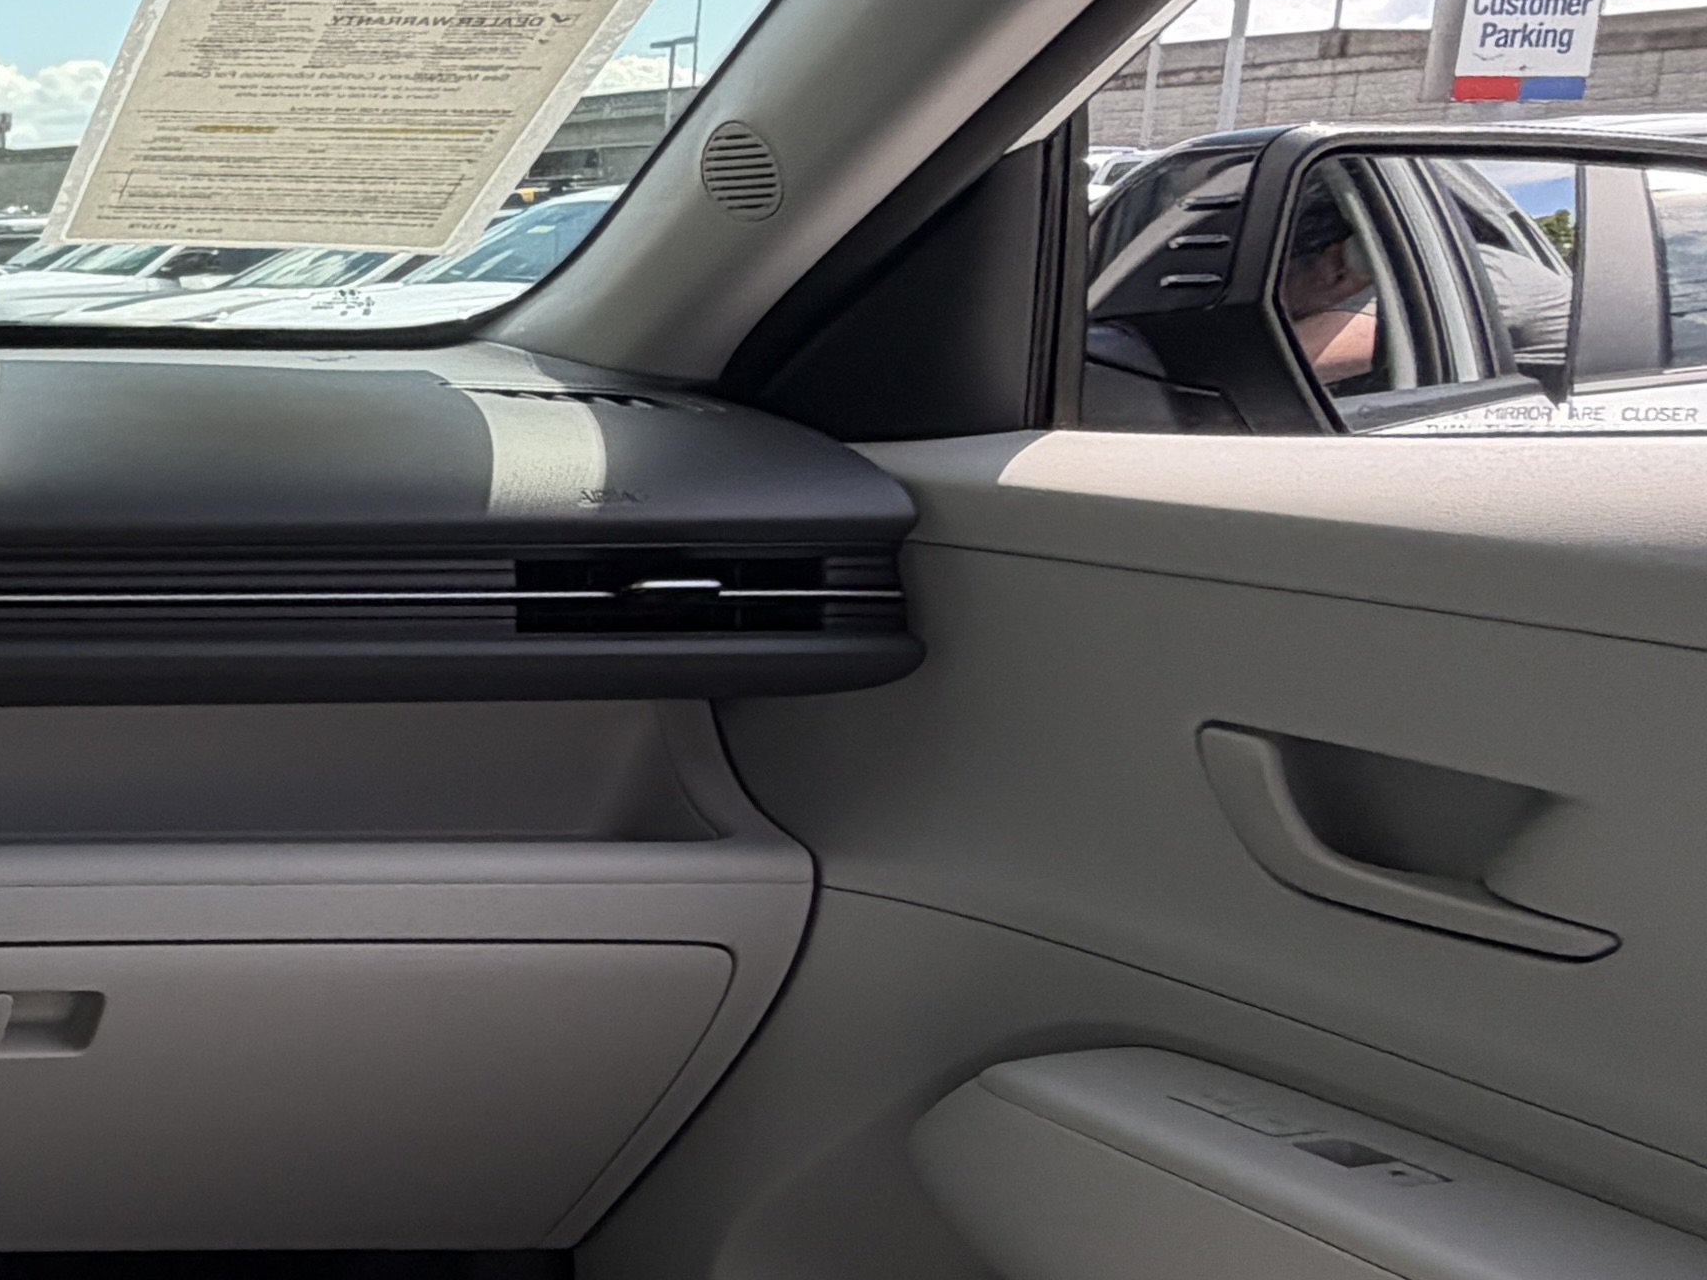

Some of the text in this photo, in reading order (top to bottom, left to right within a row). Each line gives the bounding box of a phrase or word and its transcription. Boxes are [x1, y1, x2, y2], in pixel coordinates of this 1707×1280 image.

[1478, 21, 1574, 54] Parking
[1483, 405, 1699, 423] MIRROR ARE CLOSER
